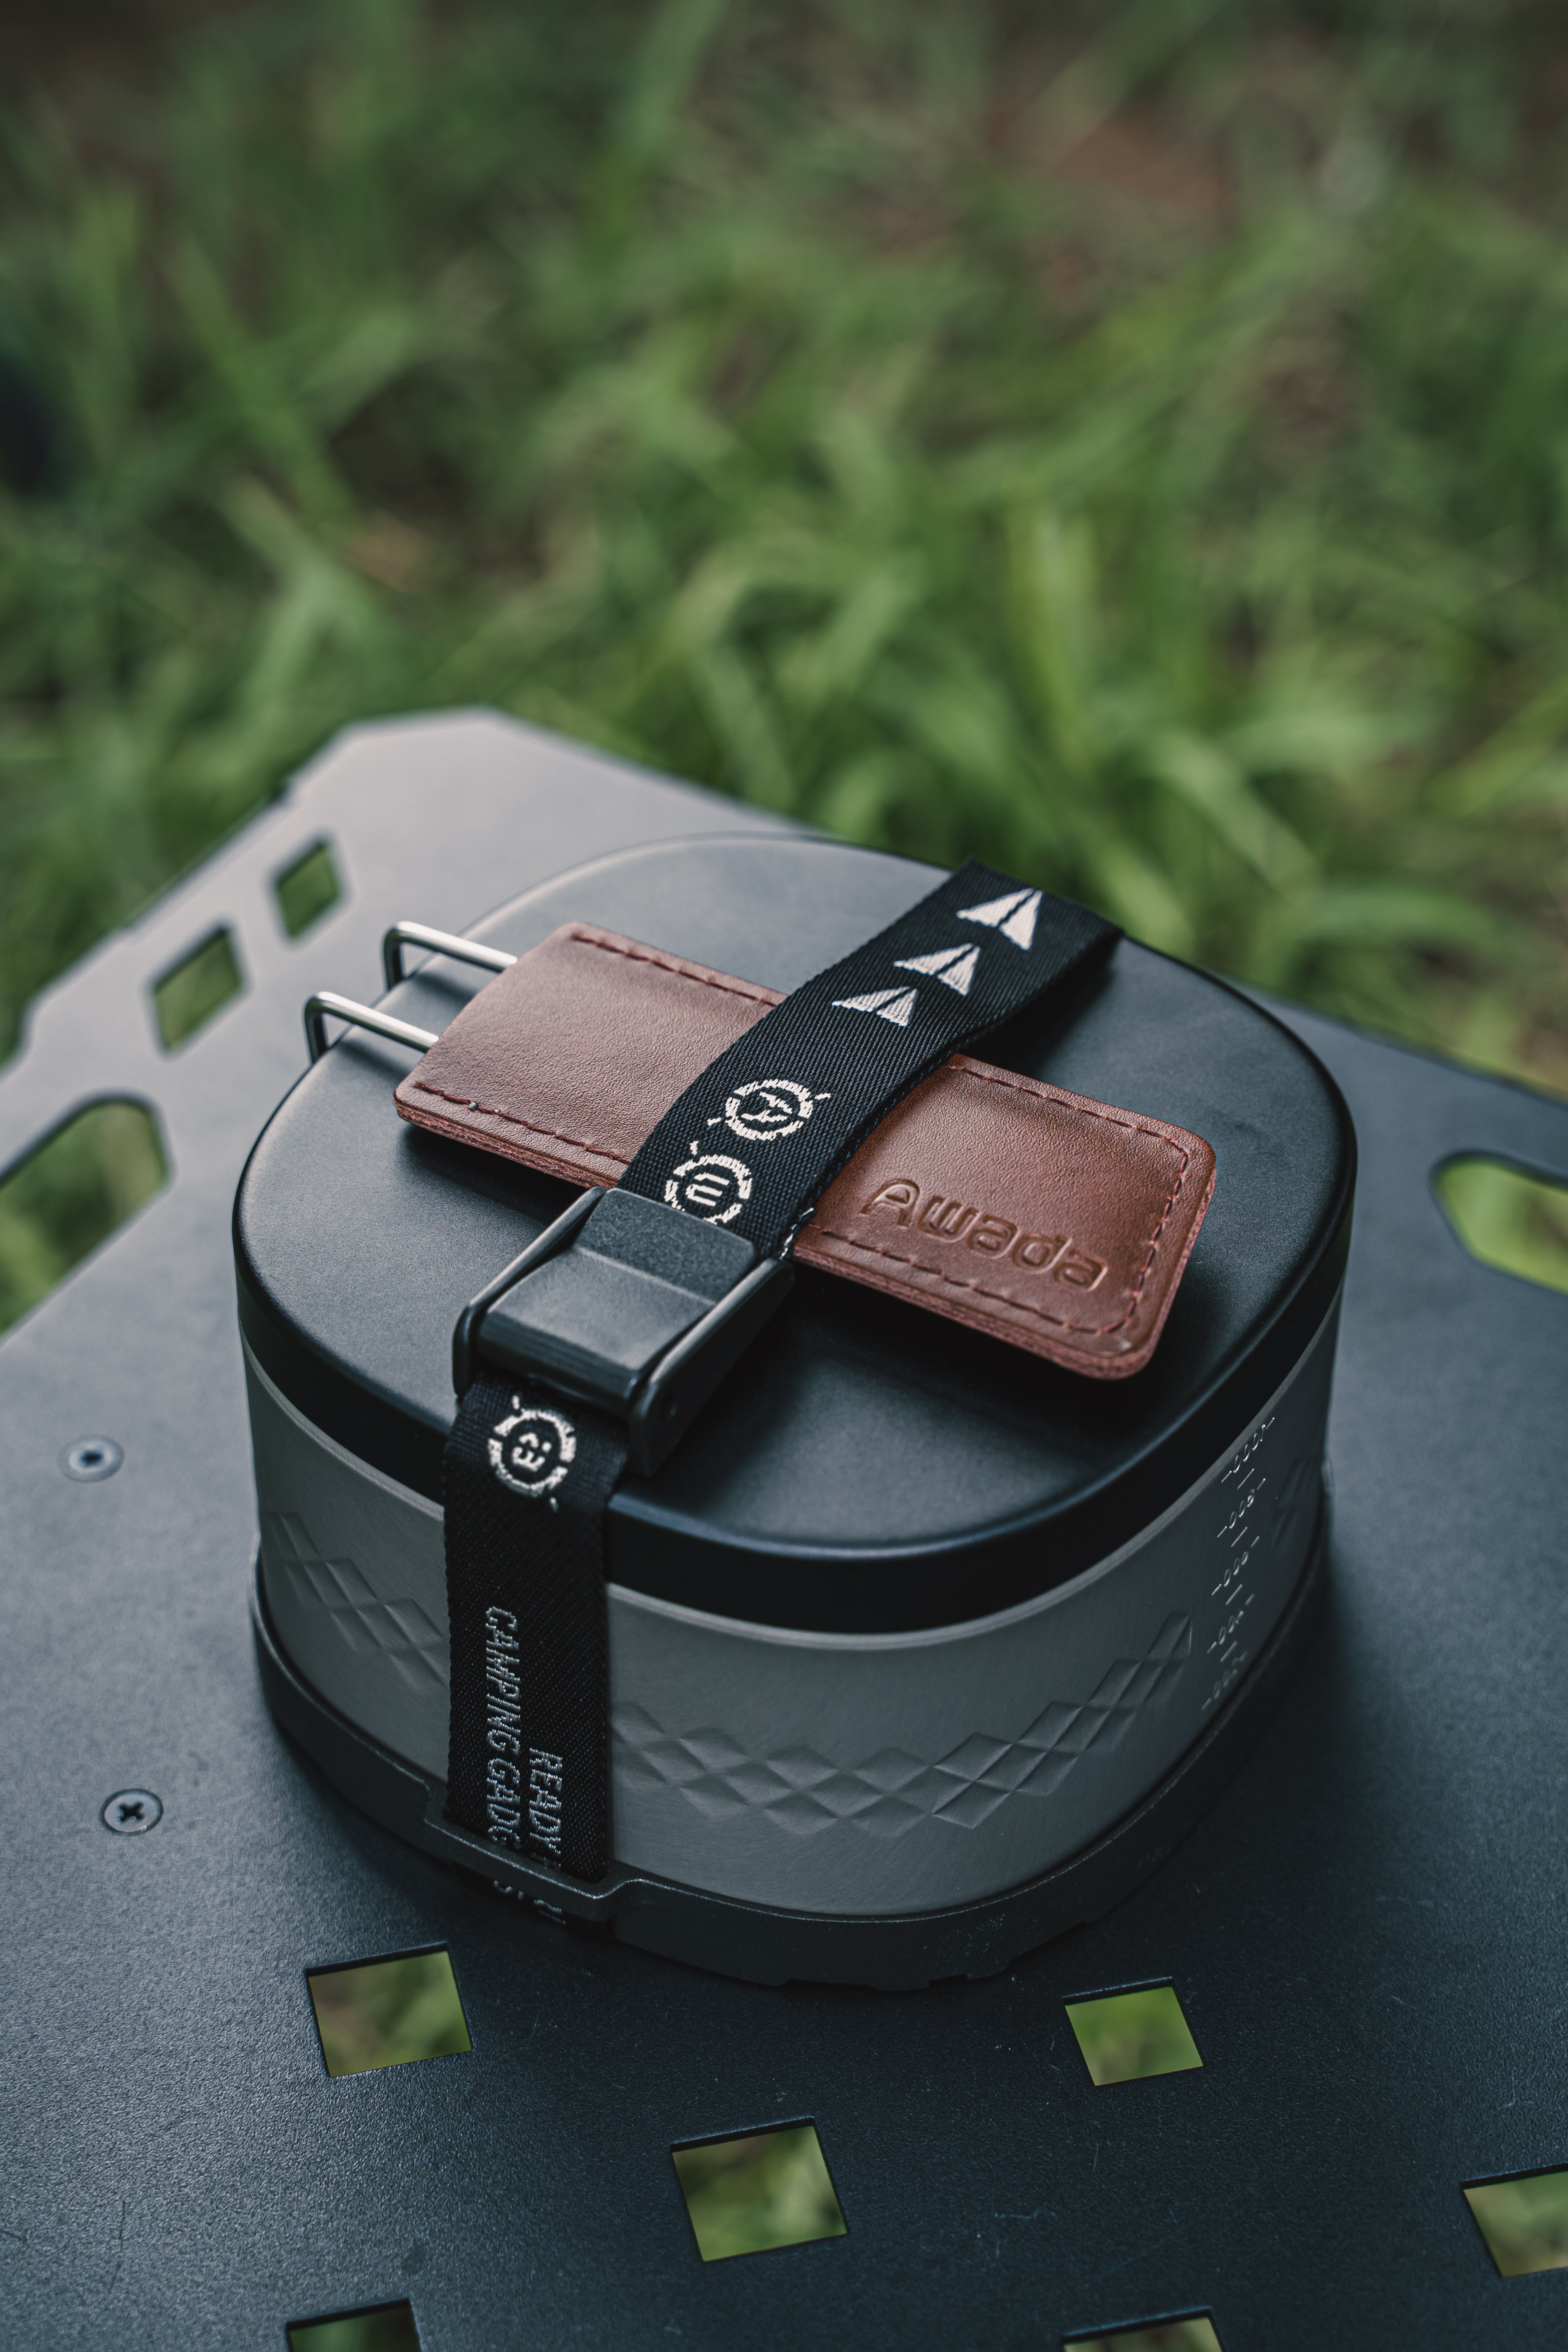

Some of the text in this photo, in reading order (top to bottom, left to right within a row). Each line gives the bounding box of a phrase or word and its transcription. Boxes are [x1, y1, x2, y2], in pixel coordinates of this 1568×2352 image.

[859, 1177, 1109, 1293] Awada
[485, 1606, 521, 1756] CAMPING
[529, 1747, 563, 1856] READY
